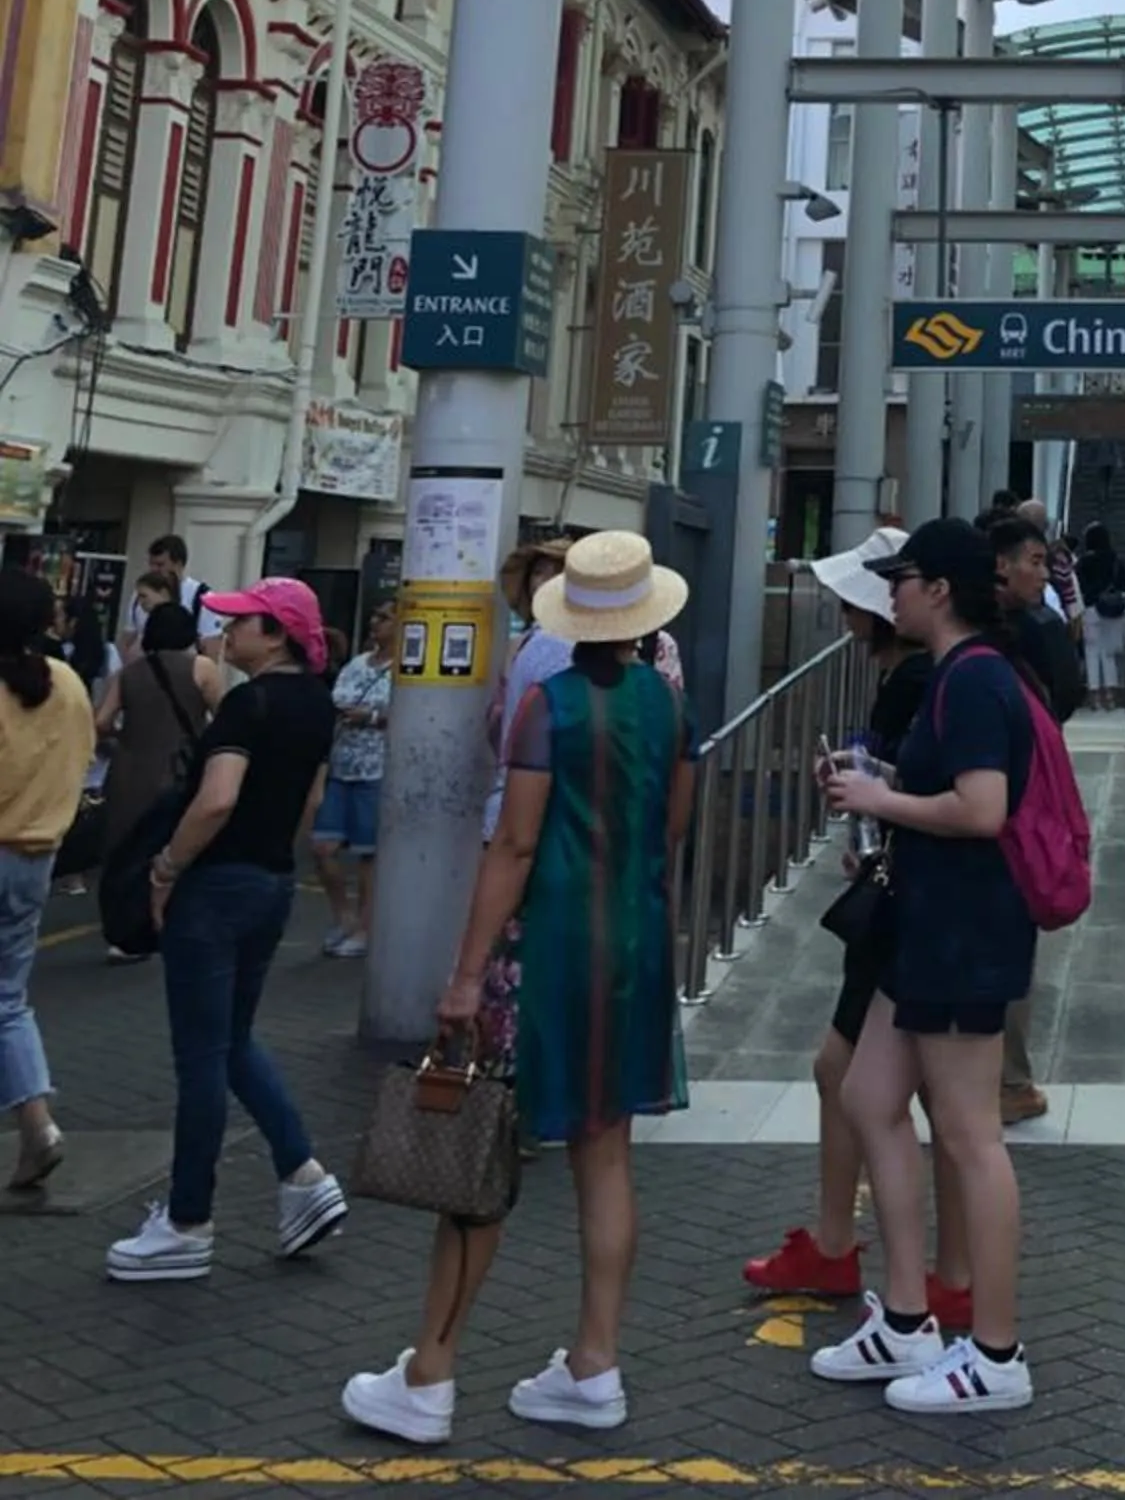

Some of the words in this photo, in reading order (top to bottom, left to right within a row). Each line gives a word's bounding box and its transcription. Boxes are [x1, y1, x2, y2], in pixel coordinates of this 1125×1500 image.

[612, 161, 664, 388] 川苑酒家
[413, 295, 511, 315] ENTRANCE
[436, 324, 485, 346] 入口
